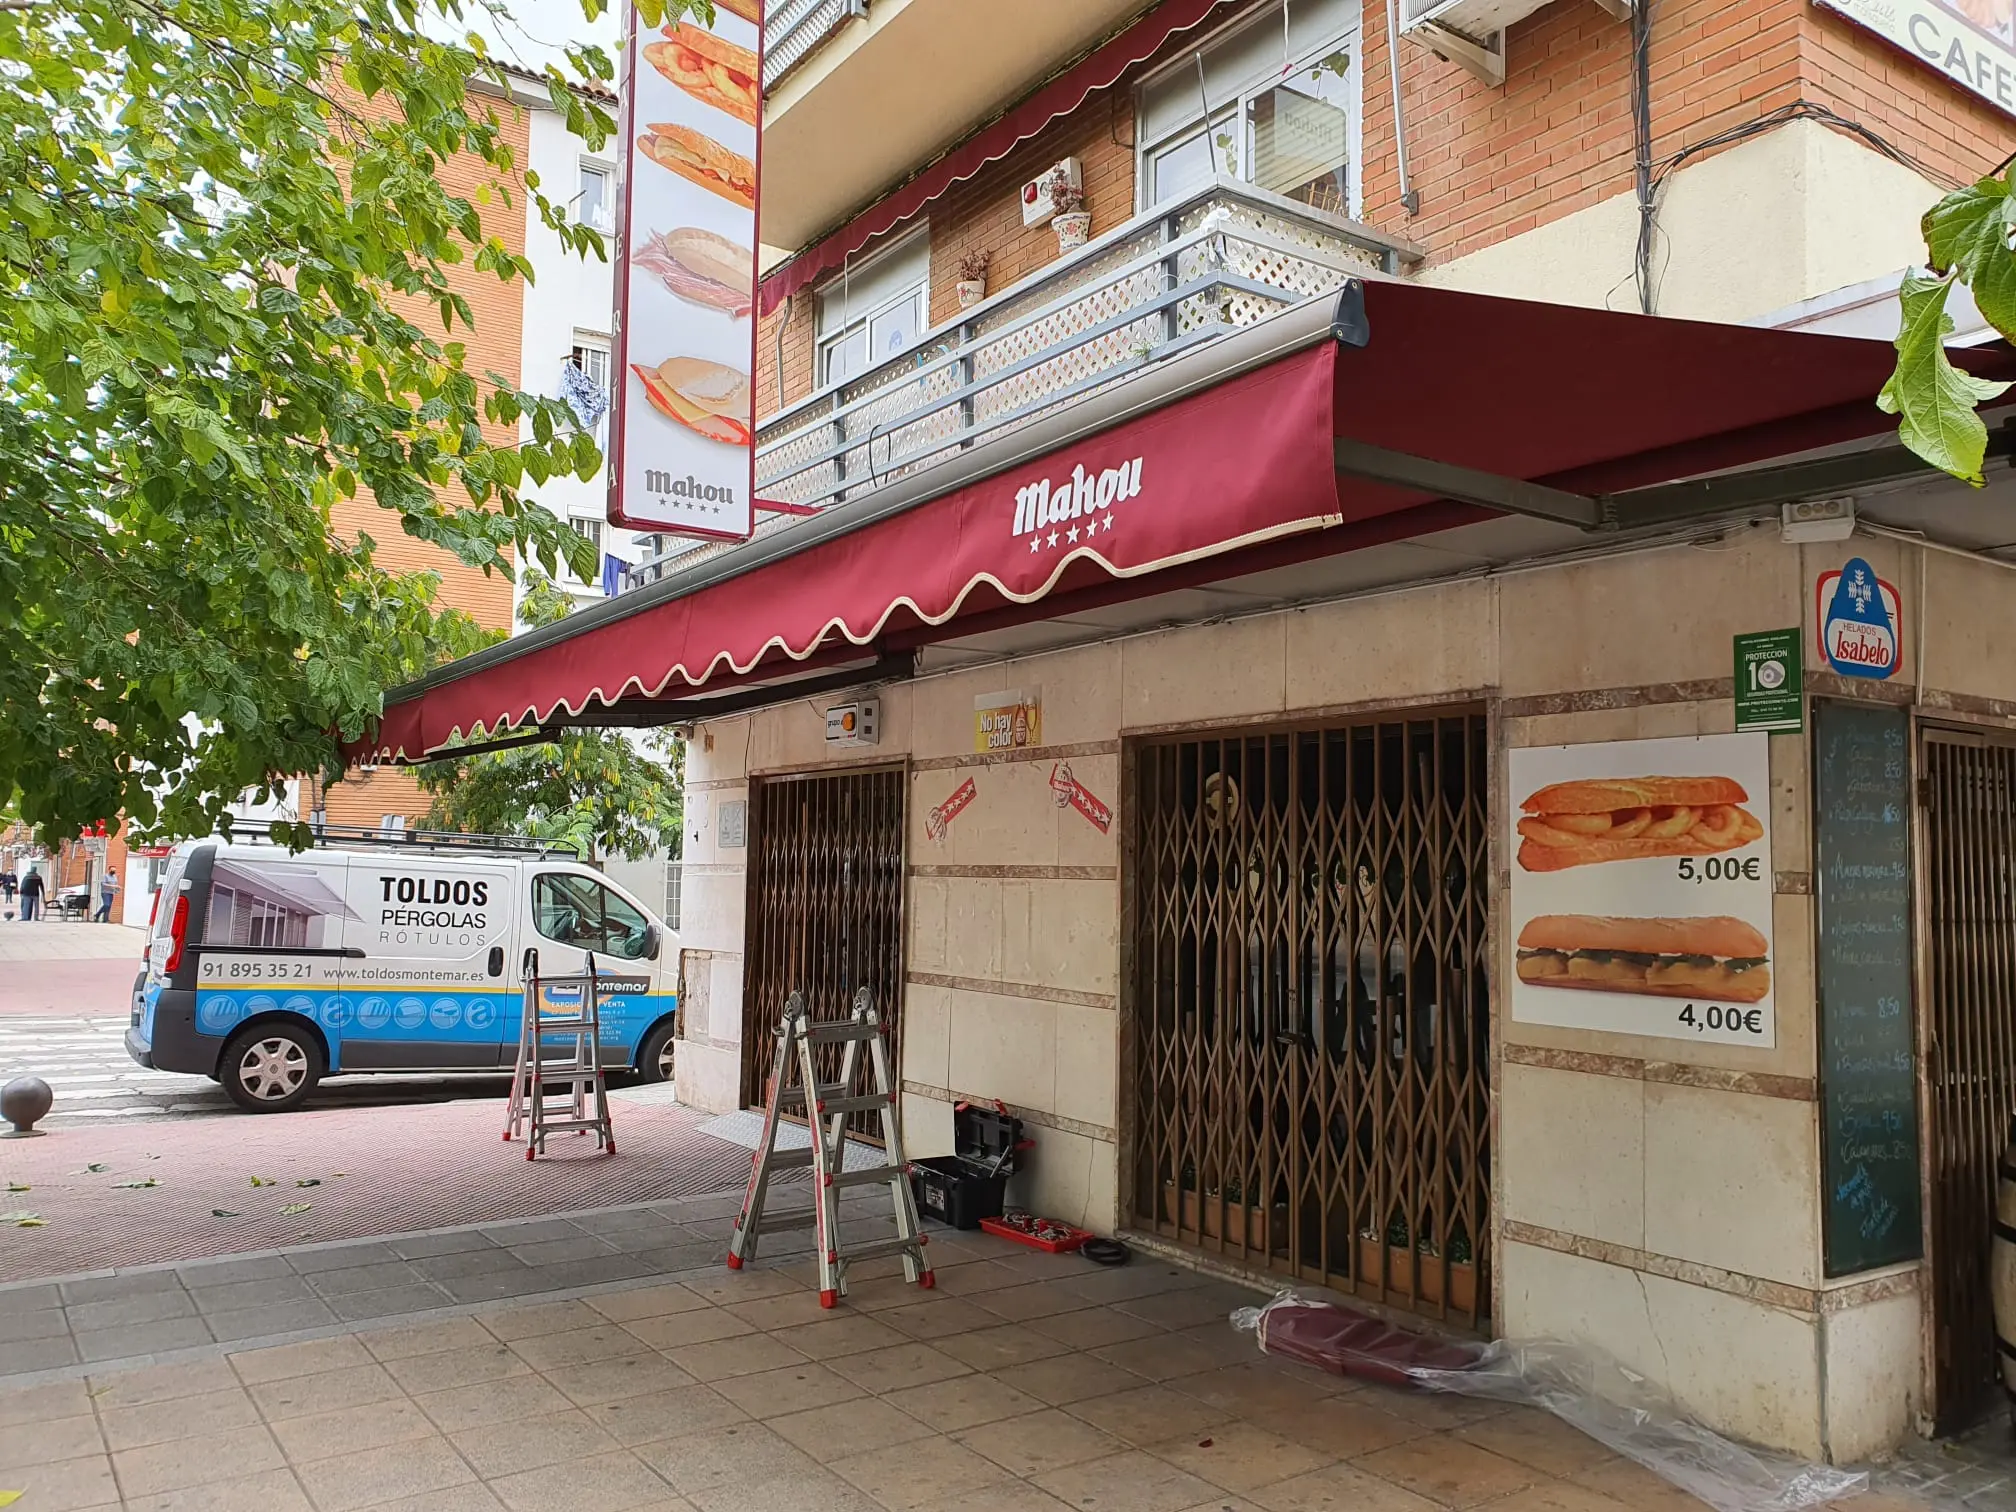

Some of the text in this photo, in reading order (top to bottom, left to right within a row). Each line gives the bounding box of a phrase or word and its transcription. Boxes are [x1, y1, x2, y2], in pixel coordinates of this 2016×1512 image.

[1908, 13, 2016, 108] CAFE
[645, 469, 734, 505] Mahou
[1012, 456, 1143, 536] Mahou
[1843, 623, 1877, 637] HELADOS
[1745, 649, 1788, 662] PROTECCION
[1835, 631, 1890, 666] Isabelo
[980, 711, 1012, 733] No hay
[988, 729, 1013, 749] color
[1678, 857, 1760, 884] 5,00€
[380, 876, 488, 907] TOLDOS
[381, 905, 487, 929] PÉRGOLAS
[380, 929, 486, 947] RÓTULOS
[203, 962, 485, 982] 91 895 35 21 www.toldosmontemar.es
[596, 981, 647, 992] ontemar
[1678, 1003, 1763, 1034] 4,00€
